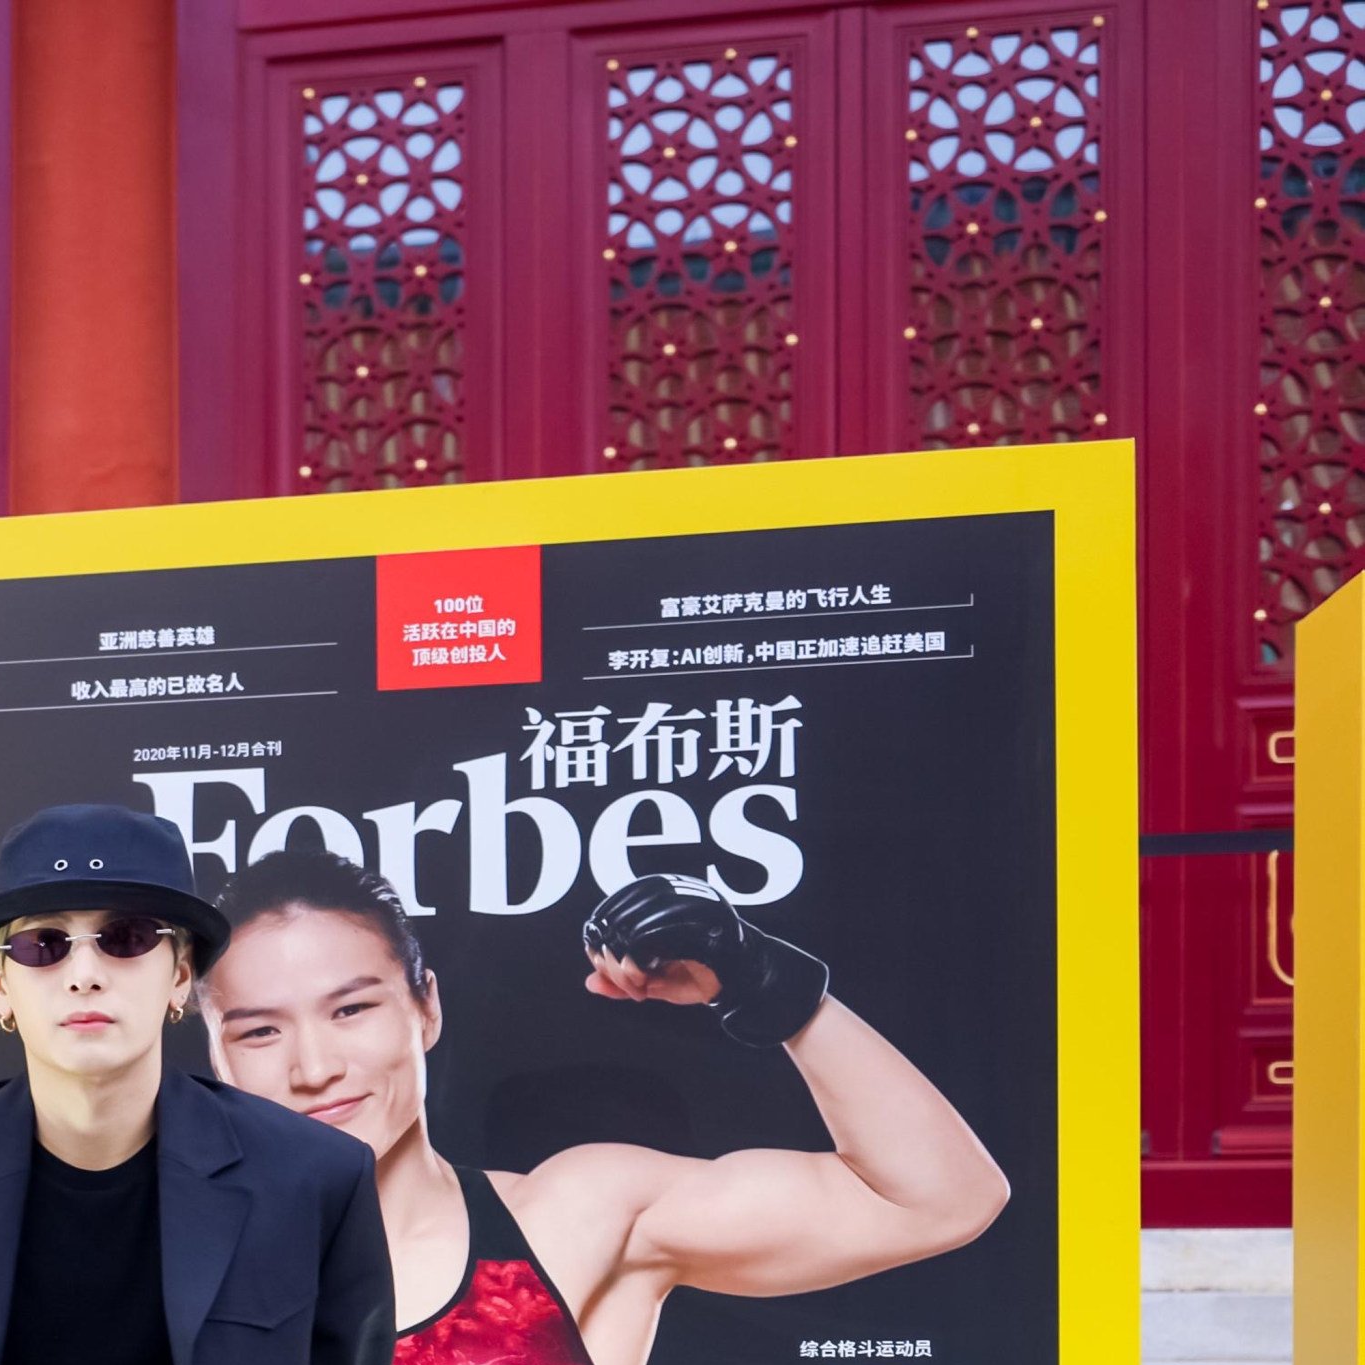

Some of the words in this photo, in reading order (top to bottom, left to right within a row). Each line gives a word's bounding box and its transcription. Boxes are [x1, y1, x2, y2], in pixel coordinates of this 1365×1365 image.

[434, 595, 484, 614] 100位
[660, 584, 892, 618] 富豪艾萨克曼的飞行人生
[99, 626, 215, 651] 亚洲慈善英雄
[403, 618, 516, 642] 活跃在中国的
[412, 643, 506, 667] 顶级创投人
[71, 672, 244, 700] 收入最高的已故名人
[133, 741, 282, 762] 2020年11月-12月合刊
[520, 695, 802, 790] 福布斯
[799, 1340, 933, 1358] 综合格斗运动员
